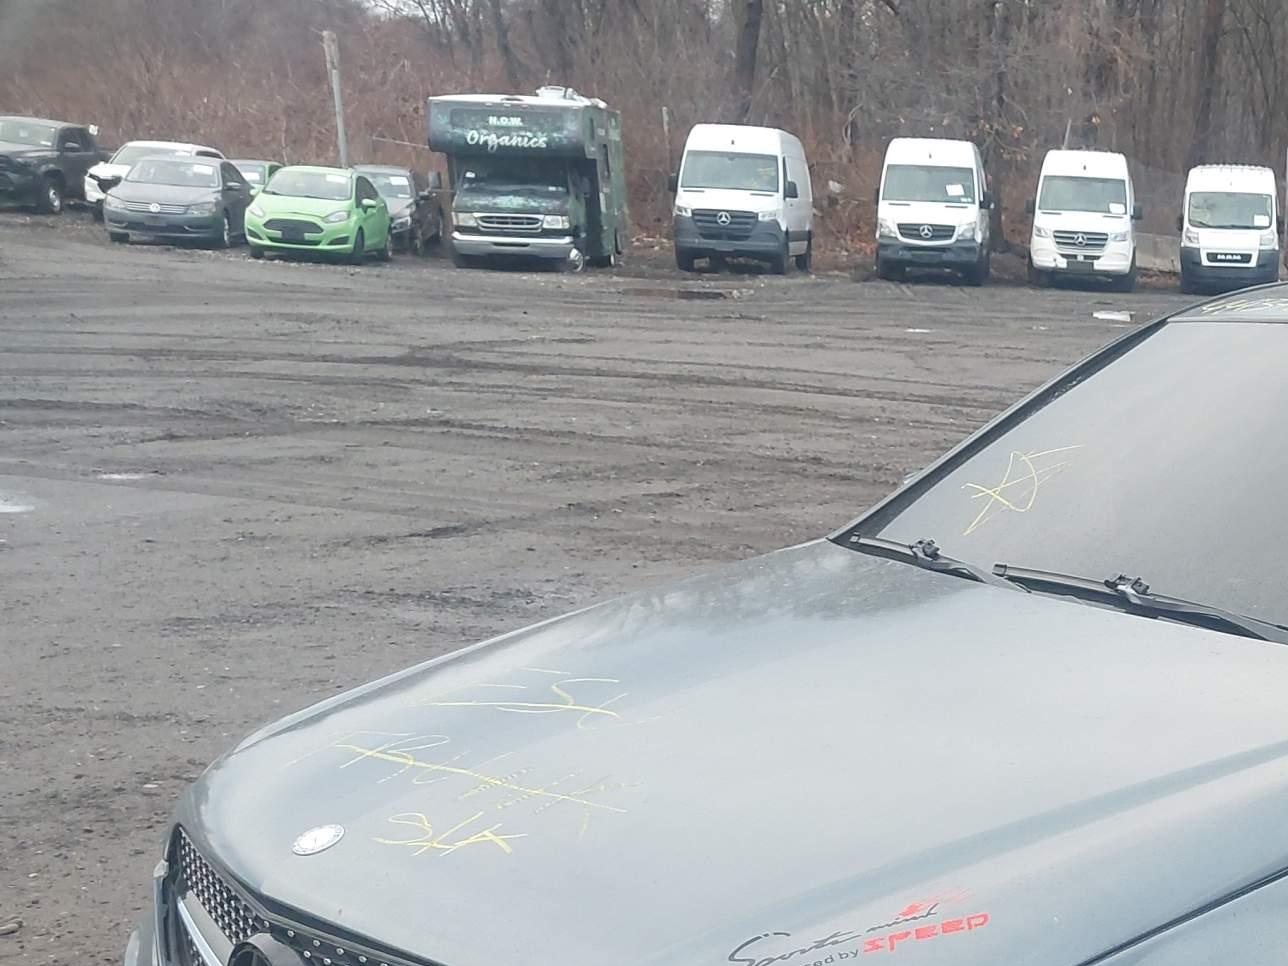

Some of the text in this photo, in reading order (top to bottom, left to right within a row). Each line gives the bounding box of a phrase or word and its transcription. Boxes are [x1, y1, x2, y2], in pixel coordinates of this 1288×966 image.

[466, 130, 547, 153] Organics
[838, 948, 860, 961] by
[863, 912, 990, 953] SPEED
